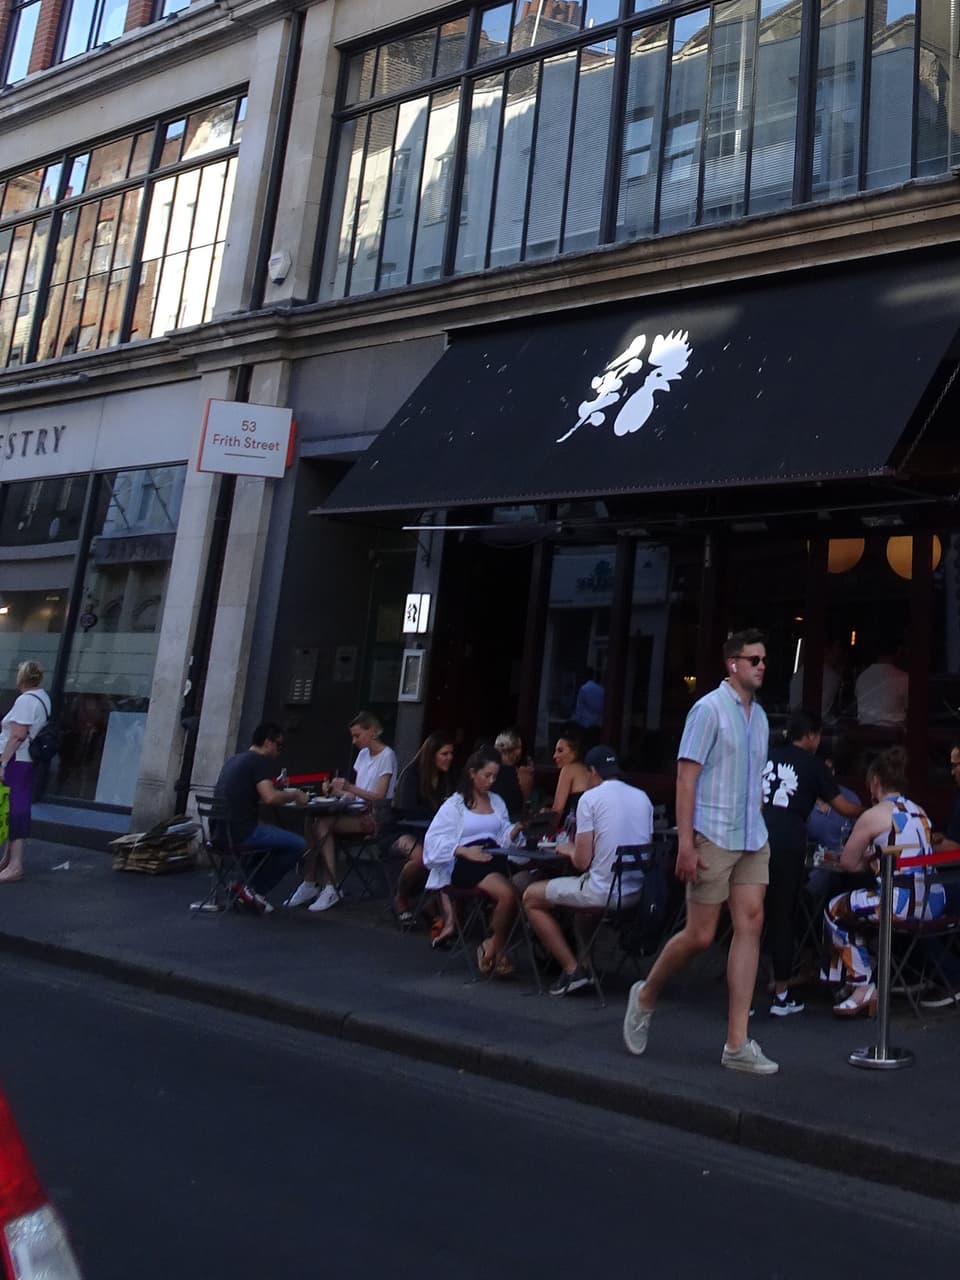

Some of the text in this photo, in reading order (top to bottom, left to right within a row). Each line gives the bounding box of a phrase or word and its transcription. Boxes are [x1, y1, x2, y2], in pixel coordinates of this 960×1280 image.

[241, 420, 257, 433] 53
[212, 433, 281, 451] Frith Street
